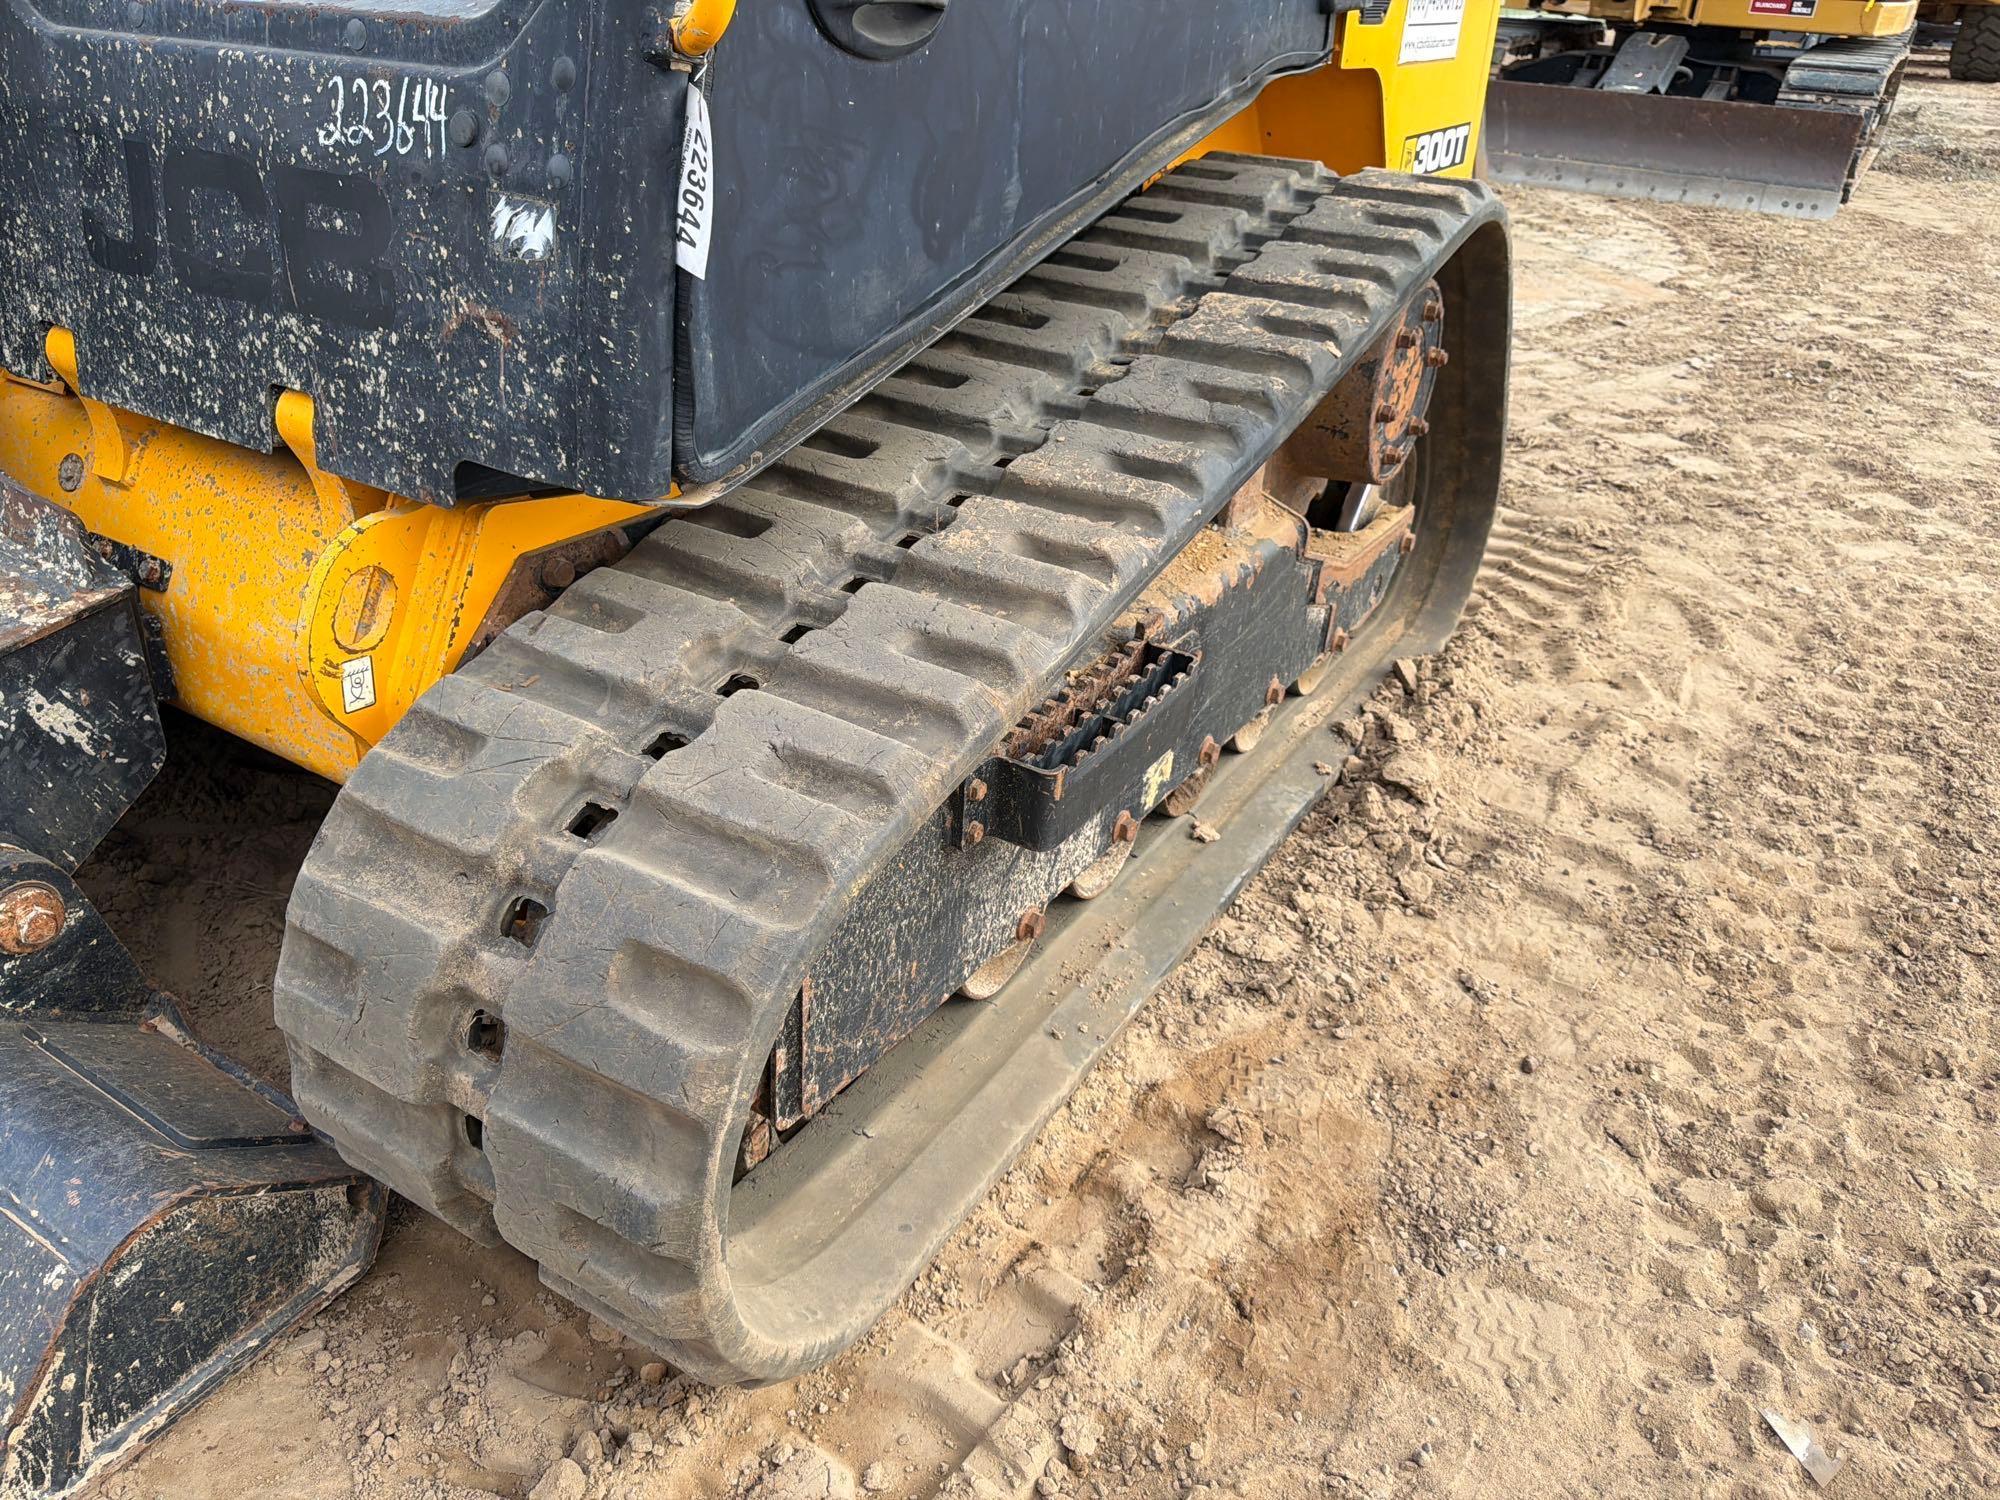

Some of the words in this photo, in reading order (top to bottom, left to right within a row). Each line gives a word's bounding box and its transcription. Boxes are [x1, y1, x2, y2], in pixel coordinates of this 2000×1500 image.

[316, 75, 448, 160] 223644
[1412, 124, 1470, 175] 300T
[82, 138, 396, 331] JCB
[676, 127, 708, 249] 223644
